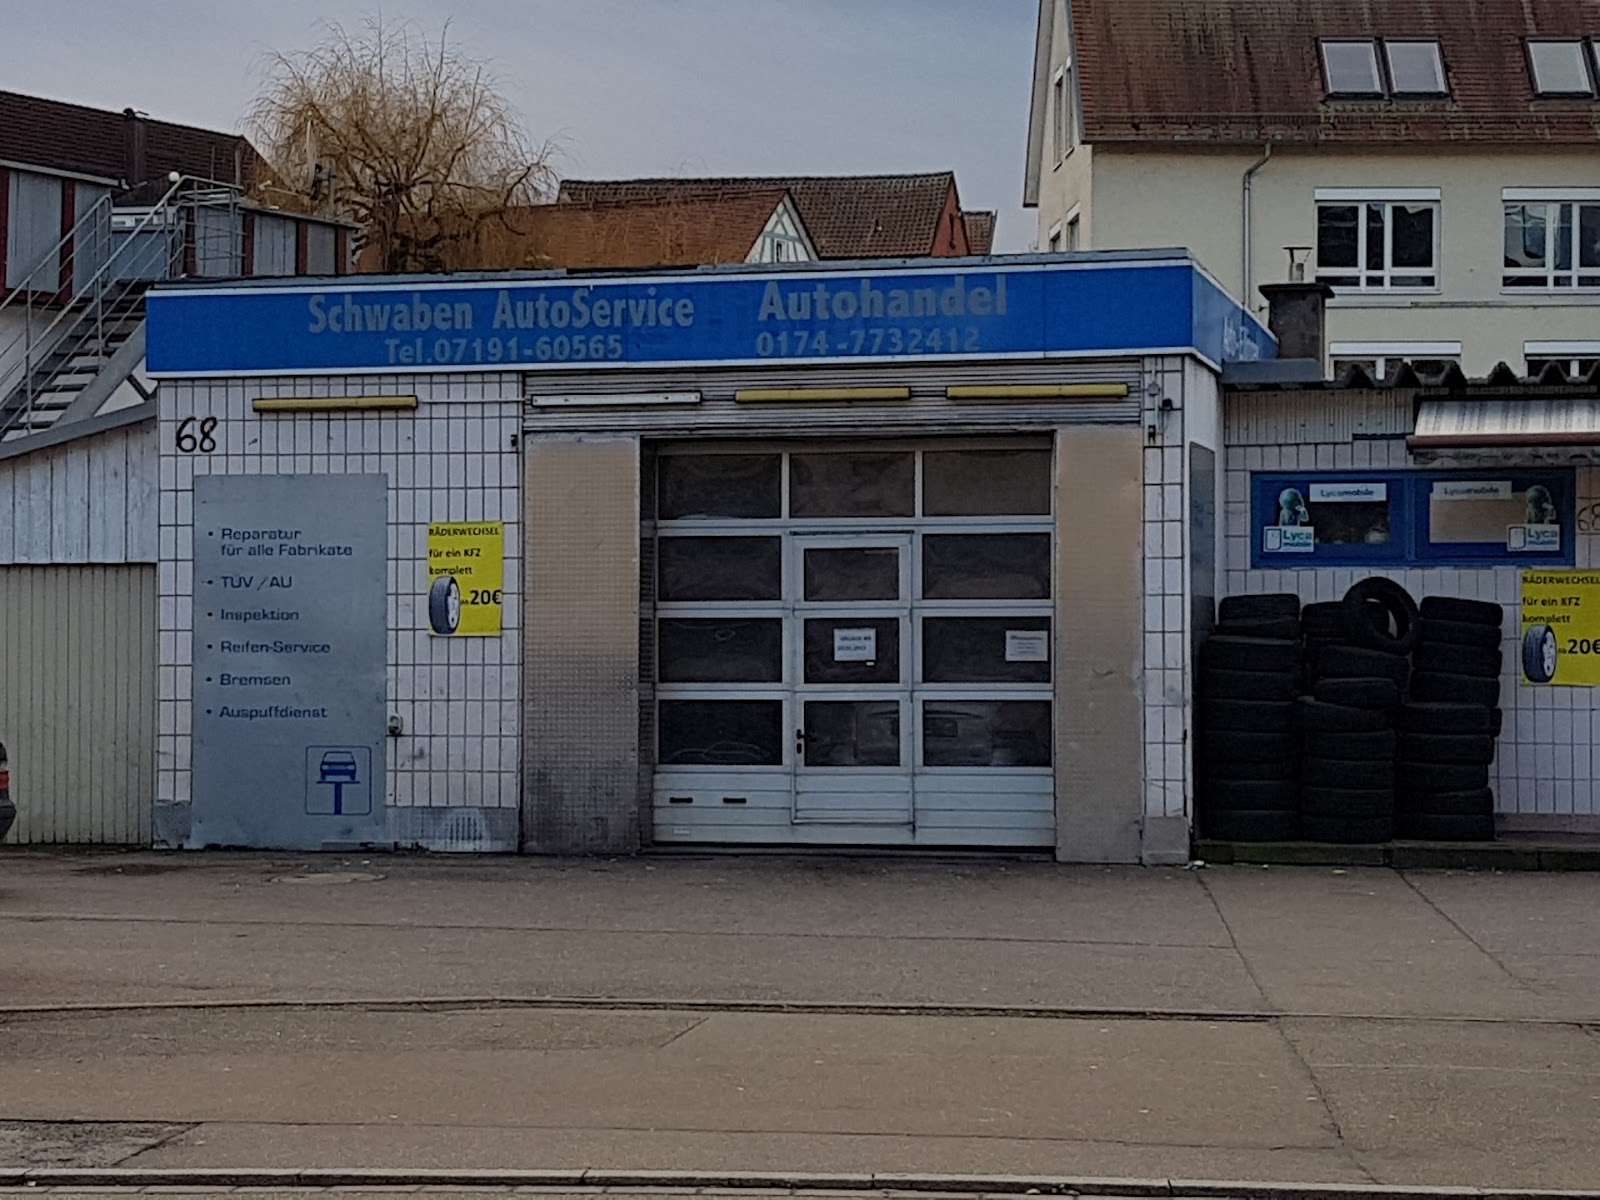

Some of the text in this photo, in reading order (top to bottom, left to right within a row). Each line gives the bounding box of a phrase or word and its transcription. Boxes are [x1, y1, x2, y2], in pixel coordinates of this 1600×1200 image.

[757, 274, 1008, 321] Autohandel
[308, 287, 695, 334] Schwaben AutoService
[386, 335, 623, 364] Tel.07191-60565
[176, 416, 218, 453] 68
[221, 528, 302, 542] Reparatur
[1283, 530, 1312, 542] Lyca
[221, 544, 352, 556] für alle Fabrikate
[428, 548, 481, 558] für ein KFZ
[470, 590, 502, 605] 20€
[1522, 597, 1581, 606] für ein KFZ
[220, 609, 299, 622] Inspektion
[220, 641, 330, 653] Reifen-Service
[220, 674, 290, 686] Bremsen
[219, 706, 328, 720] Auspuffdienst
